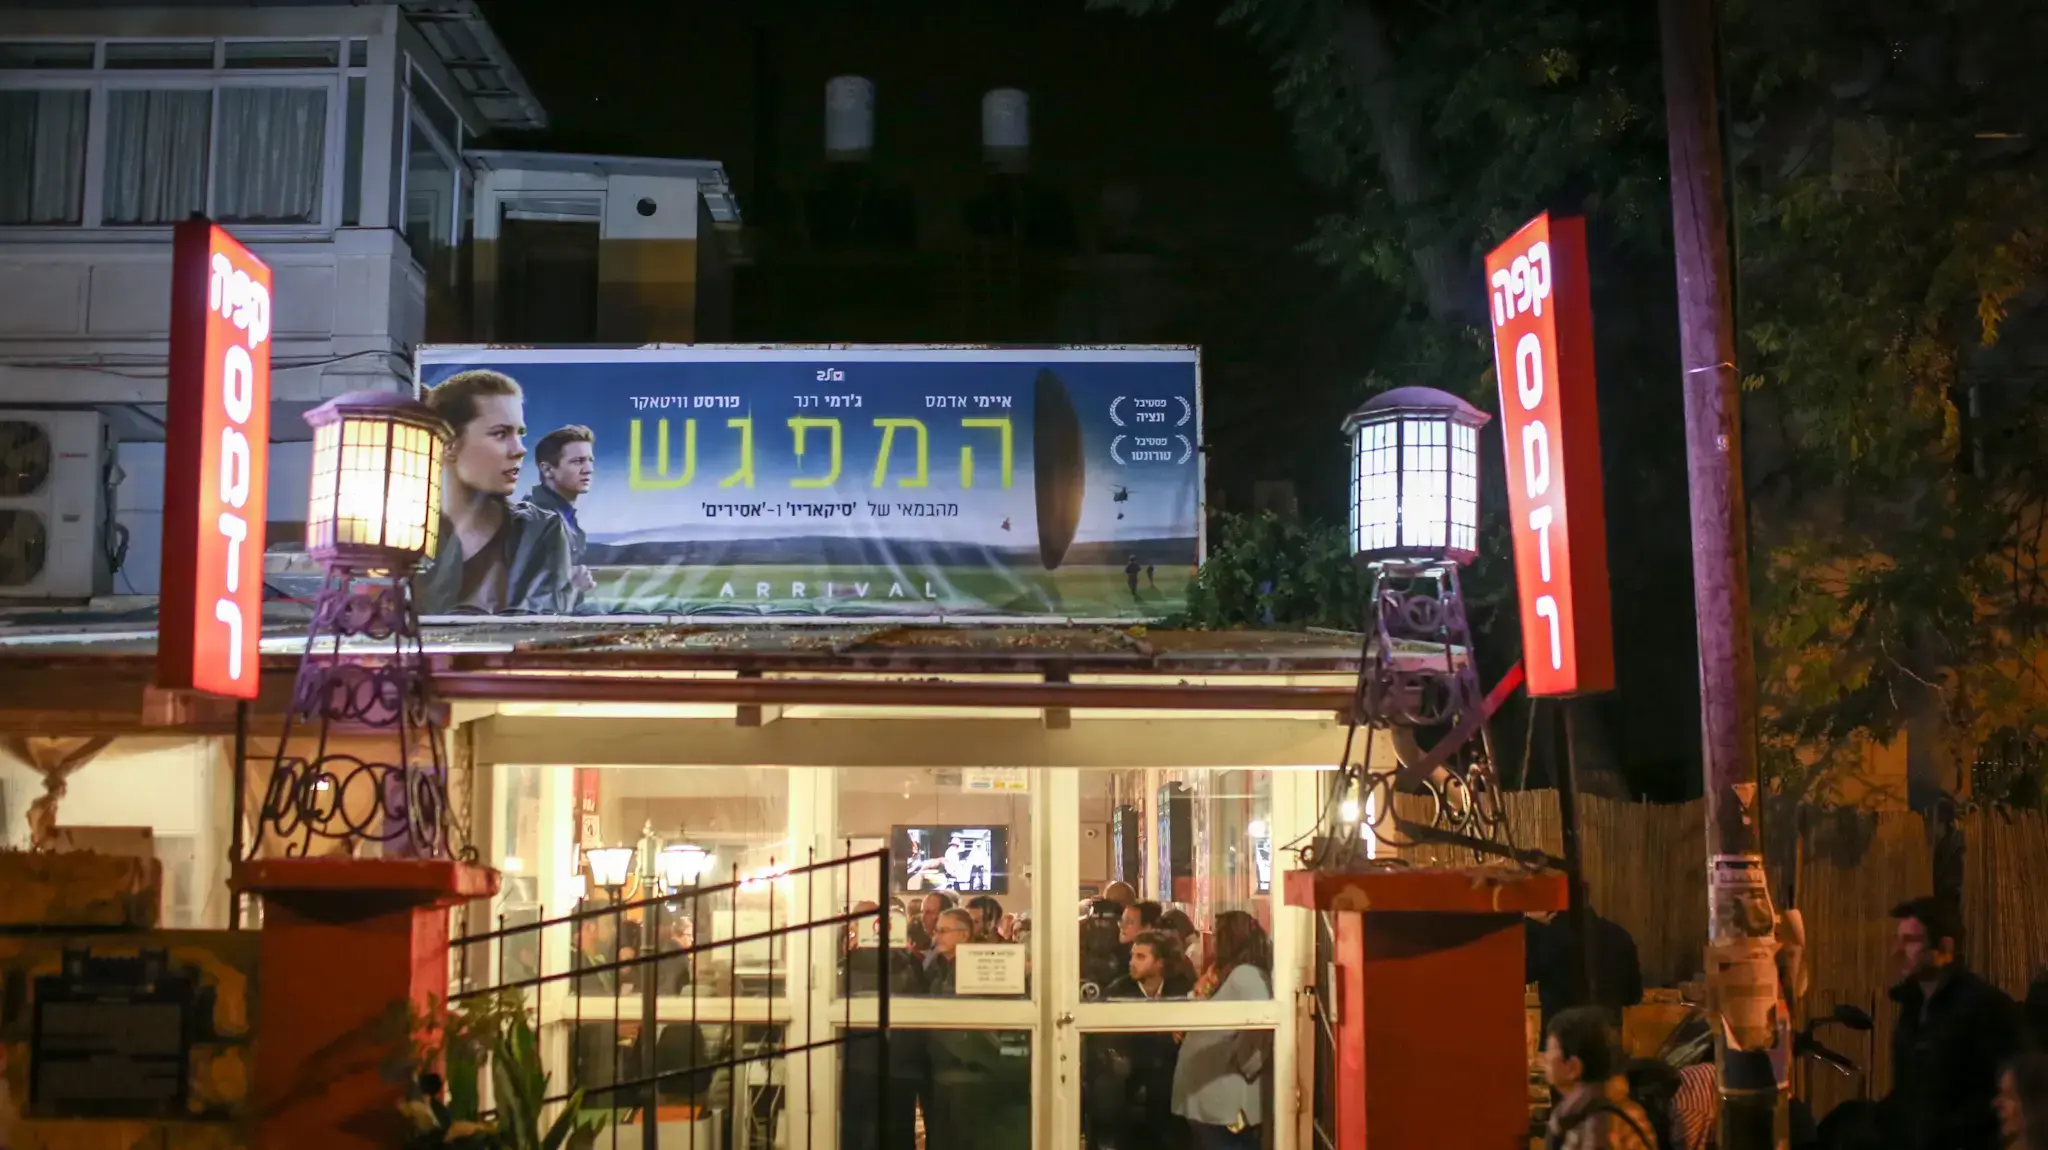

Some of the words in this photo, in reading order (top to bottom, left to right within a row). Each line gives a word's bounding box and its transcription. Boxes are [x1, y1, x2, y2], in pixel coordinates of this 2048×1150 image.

[1491, 240, 1551, 327] קפה
[210, 252, 271, 350] קפה
[630, 395, 688, 410] וויטאקר
[693, 395, 740, 409] פורסט
[793, 395, 819, 408] רנר
[824, 394, 862, 408] ג'רמי
[925, 395, 967, 408] אדמס
[973, 395, 1012, 408] איימי
[1134, 398, 1167, 408] פסטיבל
[1136, 412, 1165, 422] ונציה
[1134, 436, 1168, 446] פסטיבל
[629, 417, 1013, 489] המפגש
[1131, 451, 1172, 461] טורונטו
[1515, 332, 1562, 671] סמדר
[215, 344, 253, 680] סמדר
[867, 501, 890, 517] של
[897, 502, 959, 517] מהבמאי
[719, 582, 937, 598] ARRIVAL
